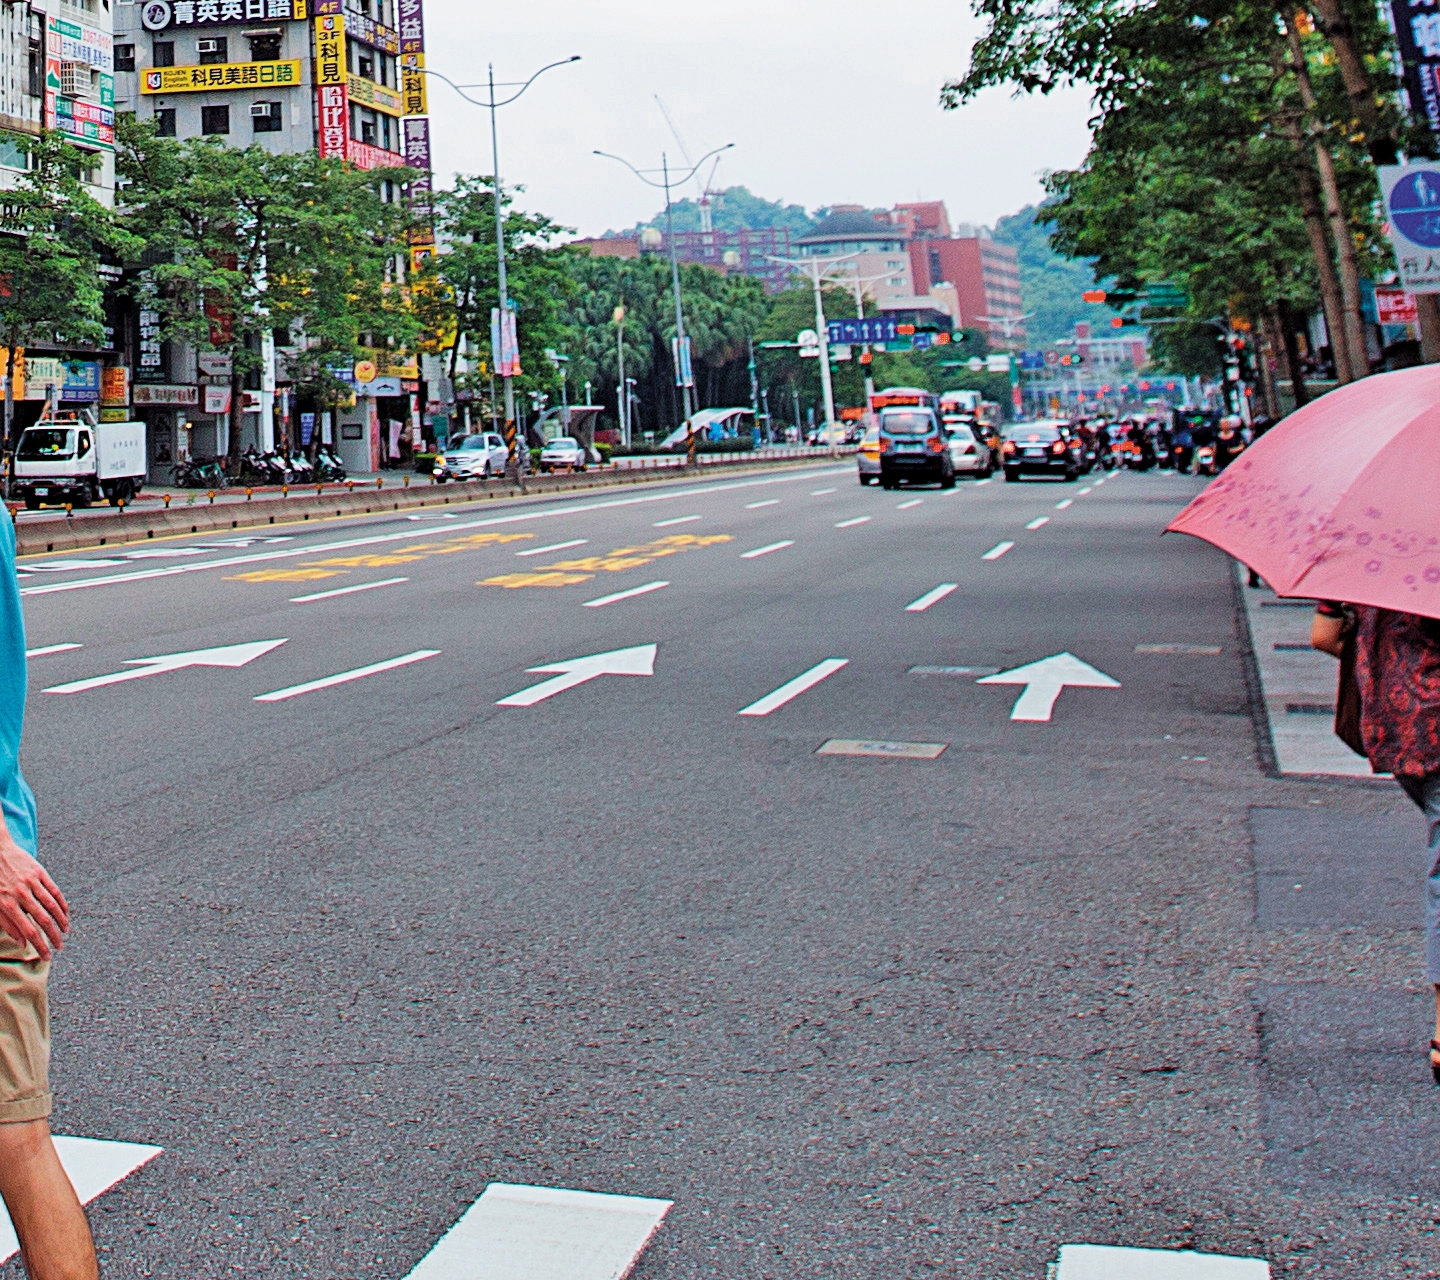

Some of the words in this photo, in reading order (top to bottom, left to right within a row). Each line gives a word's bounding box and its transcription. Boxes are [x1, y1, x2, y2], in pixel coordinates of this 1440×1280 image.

[319, 1, 339, 12] 4F
[319, 31, 340, 40] 3F
[404, 41, 420, 51] 4F
[321, 42, 340, 83] 科見
[192, 63, 293, 87] 科見美語日語
[405, 78, 424, 114] 科見
